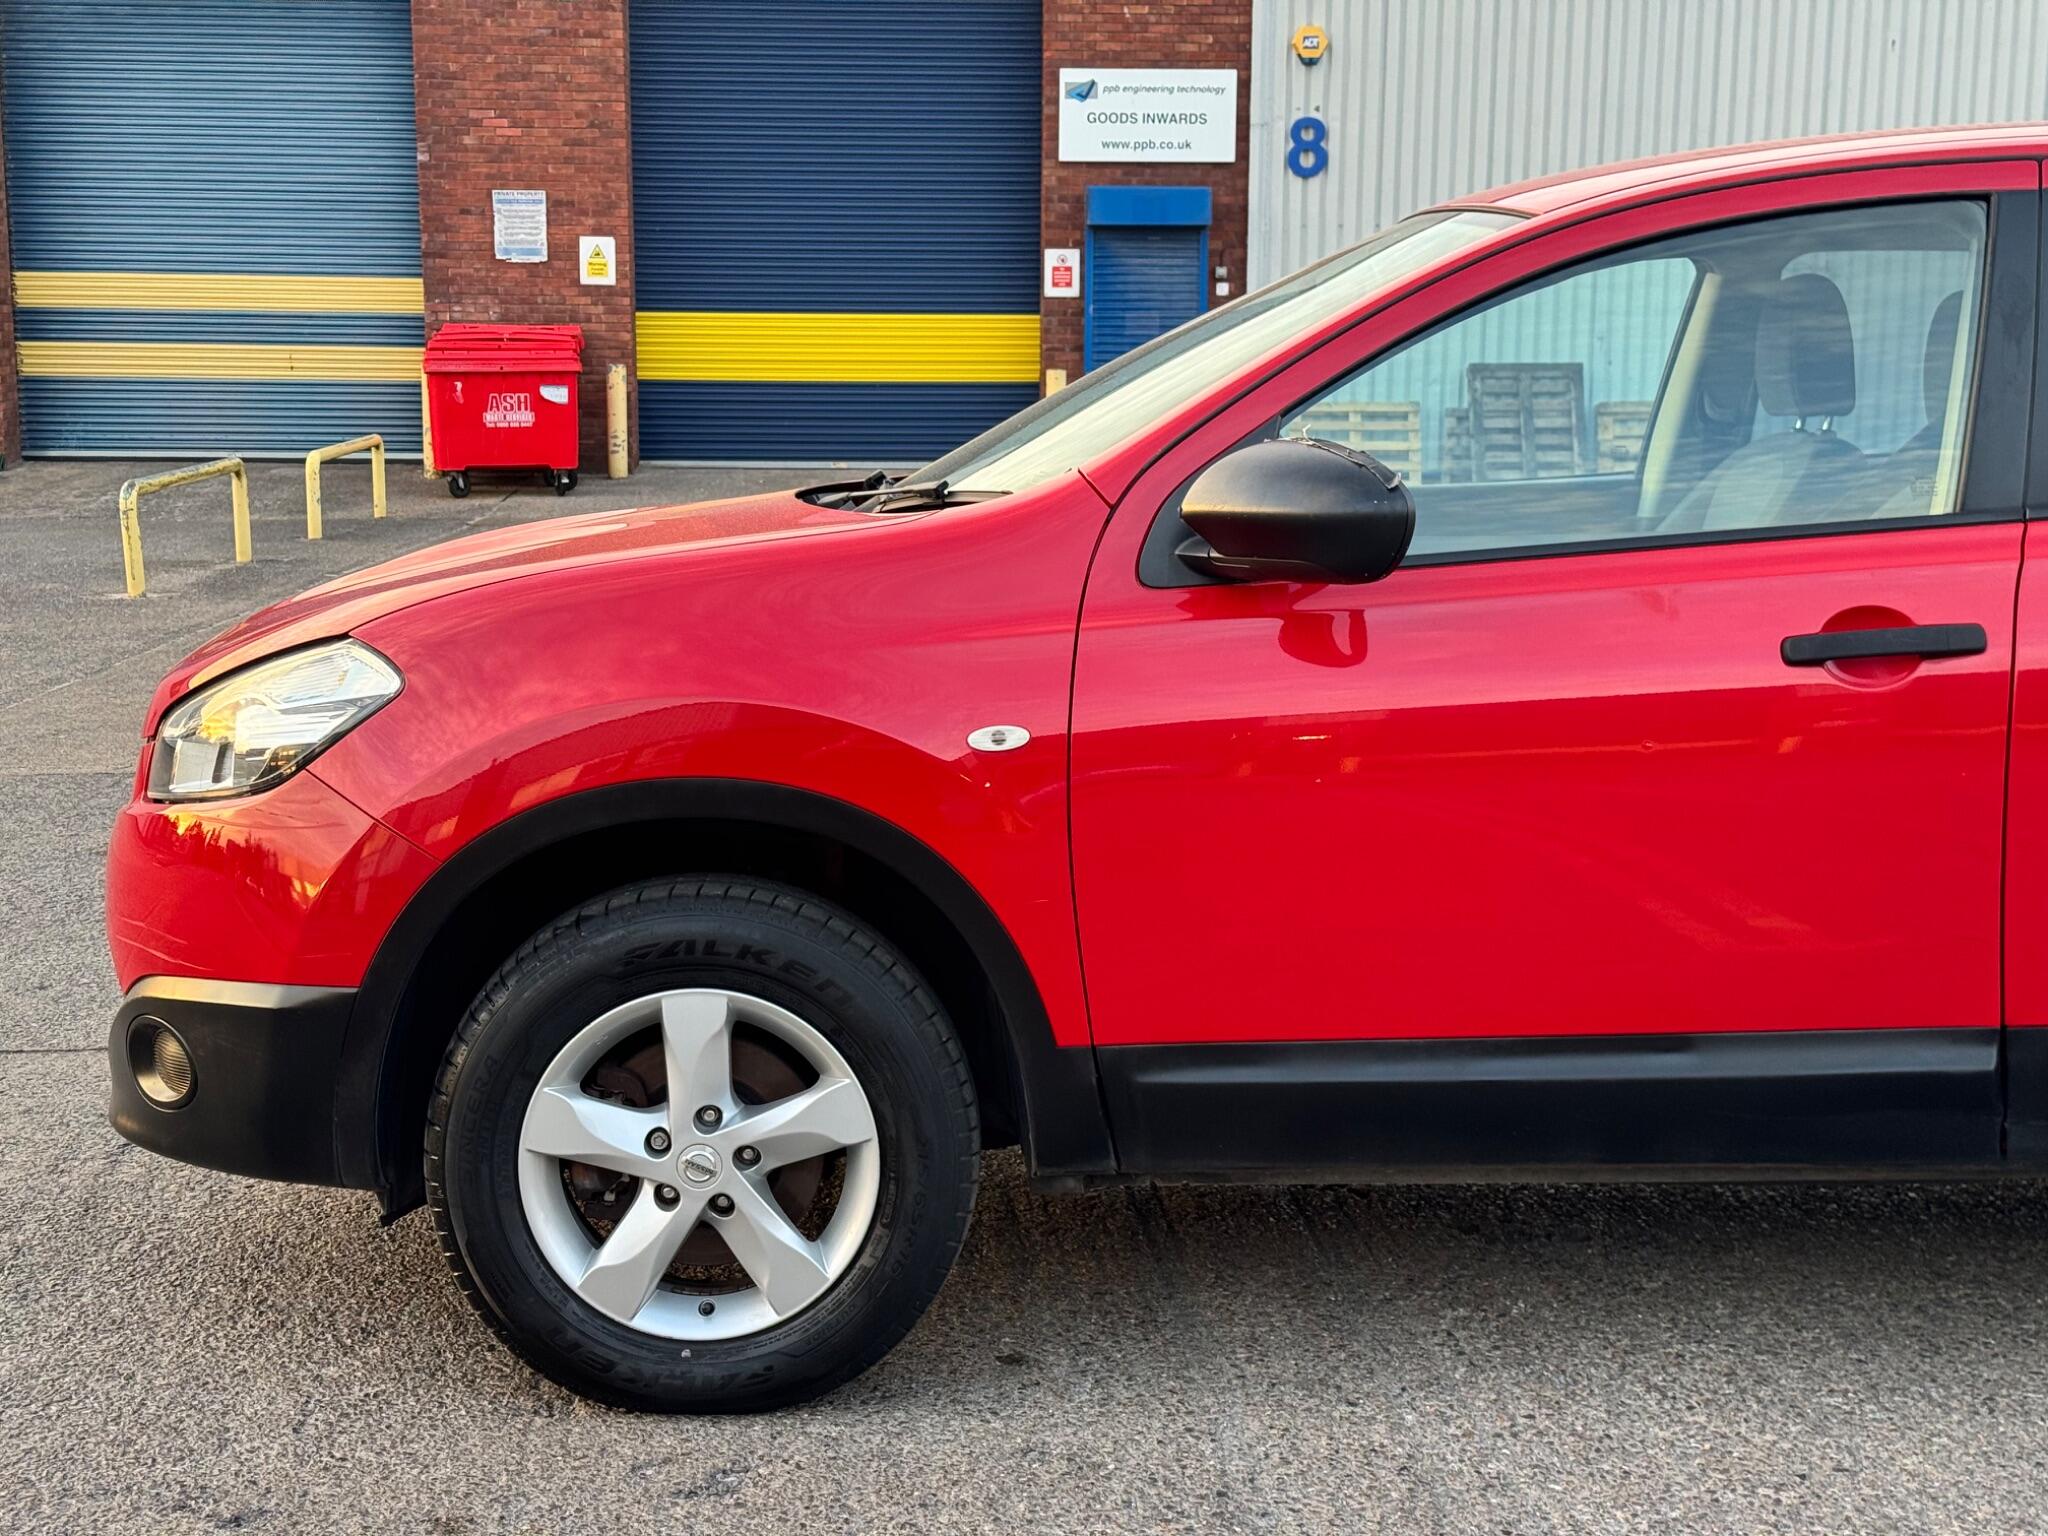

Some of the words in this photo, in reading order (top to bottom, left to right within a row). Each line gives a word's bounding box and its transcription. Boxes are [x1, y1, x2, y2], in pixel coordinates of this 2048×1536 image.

[1102, 85, 1120, 94] ppb
[1123, 84, 1175, 95] engineering
[1177, 84, 1226, 95] technology
[1087, 112, 1138, 124] GOODS
[1142, 112, 1208, 125] INWARDS
[1101, 139, 1192, 152] www.ppb.co.uk
[1288, 117, 1329, 178] 8
[488, 393, 530, 412] ASH
